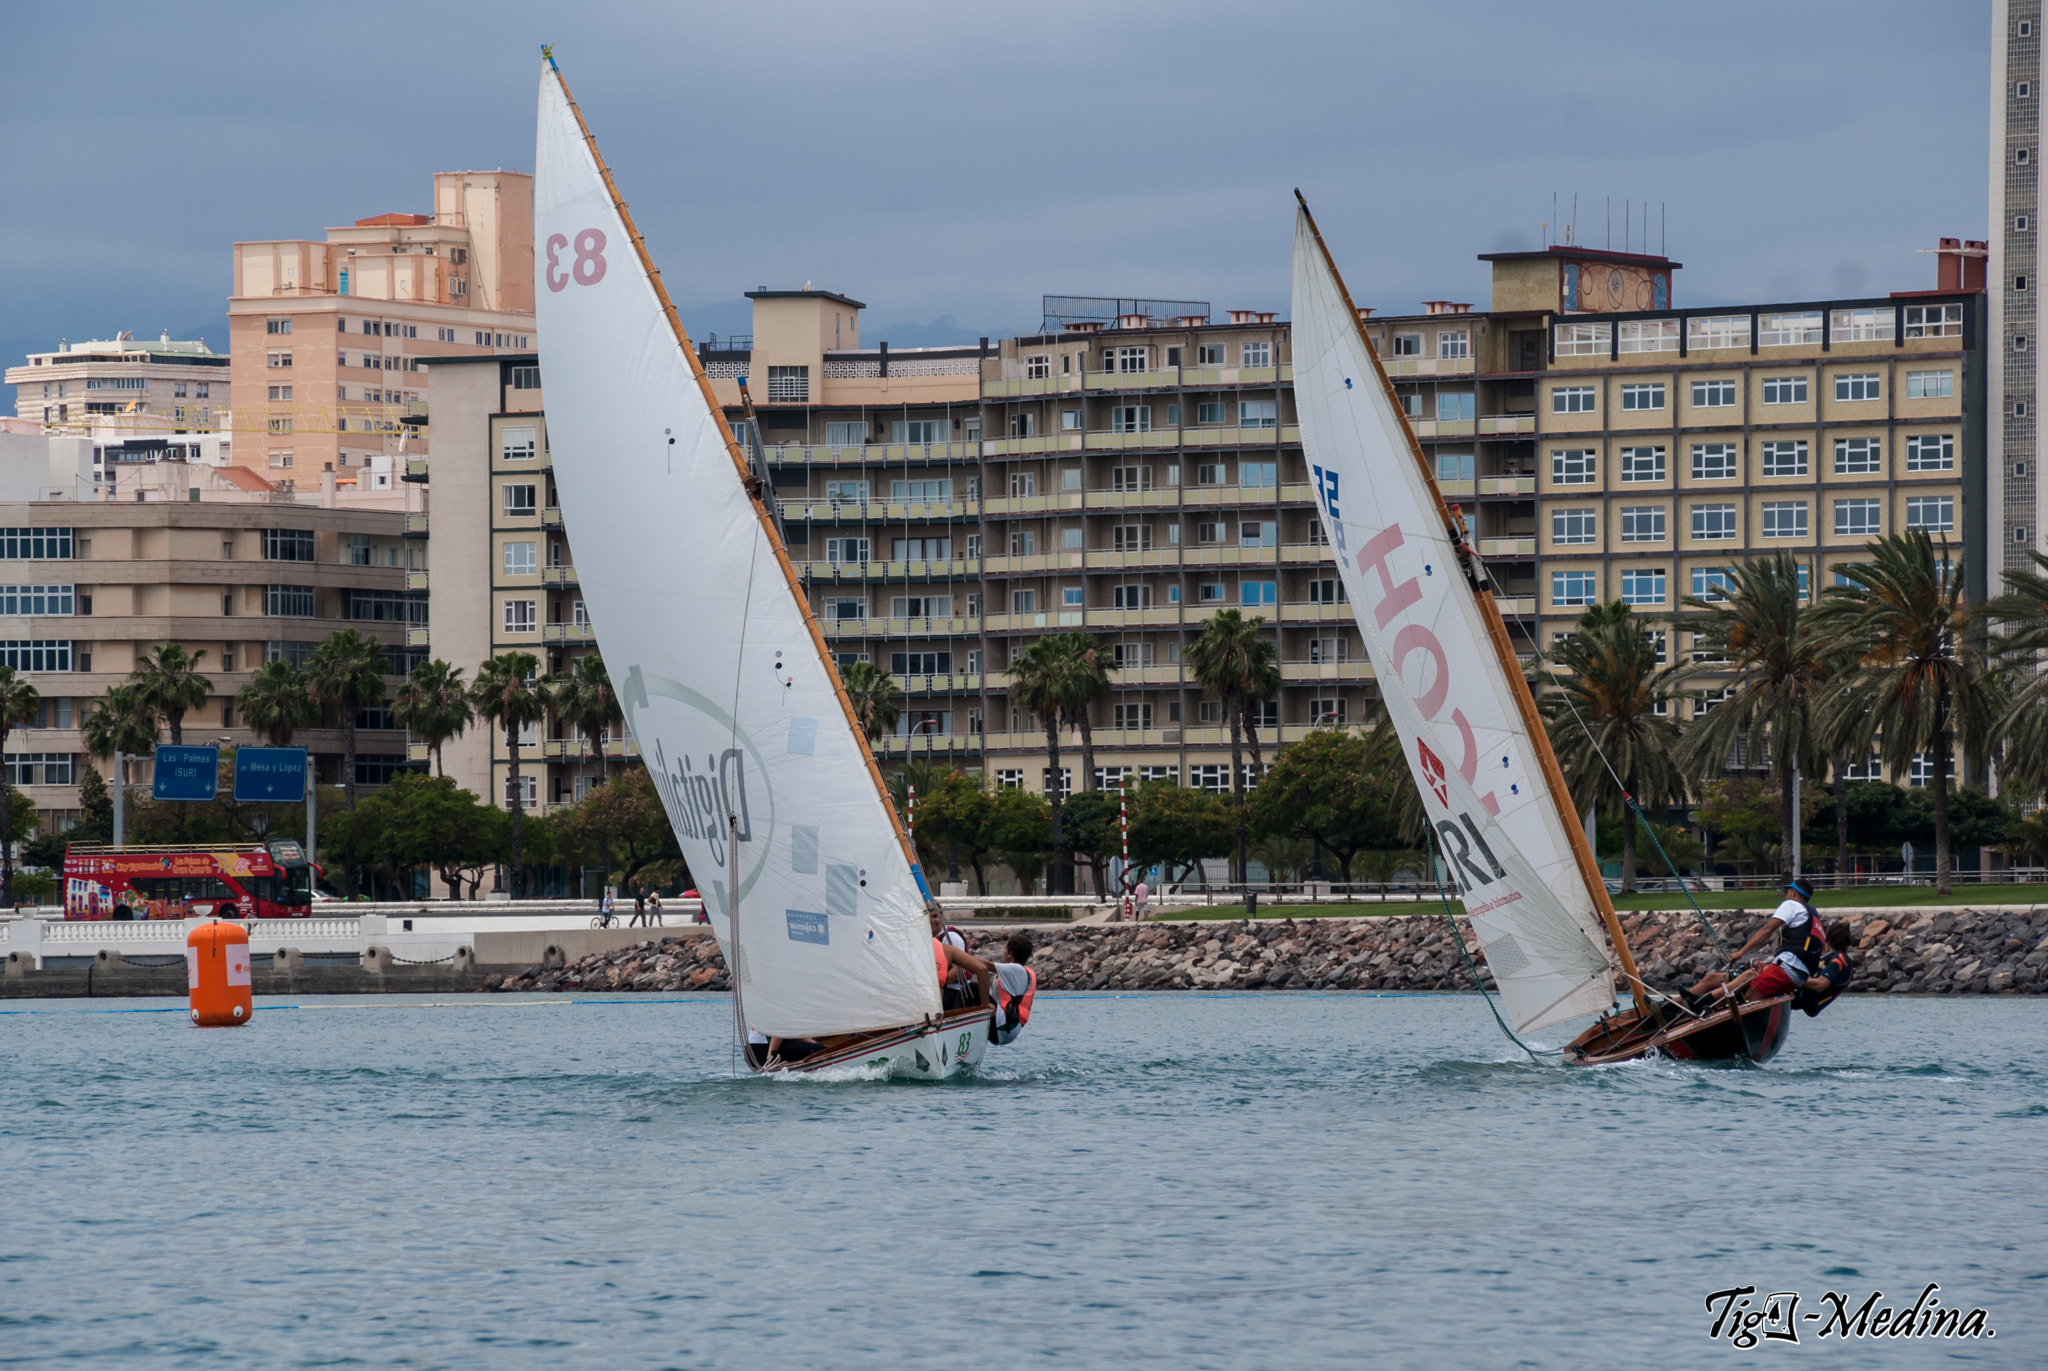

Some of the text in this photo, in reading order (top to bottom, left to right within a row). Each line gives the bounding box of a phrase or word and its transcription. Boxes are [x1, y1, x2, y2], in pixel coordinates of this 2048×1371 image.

[163, 752, 211, 764] Las Palmas
[174, 767, 197, 778] (SUR)
[250, 762, 270, 772] Mesa
[272, 764, 276, 774] y
[279, 762, 302, 774] López
[957, 1031, 971, 1056] 83
